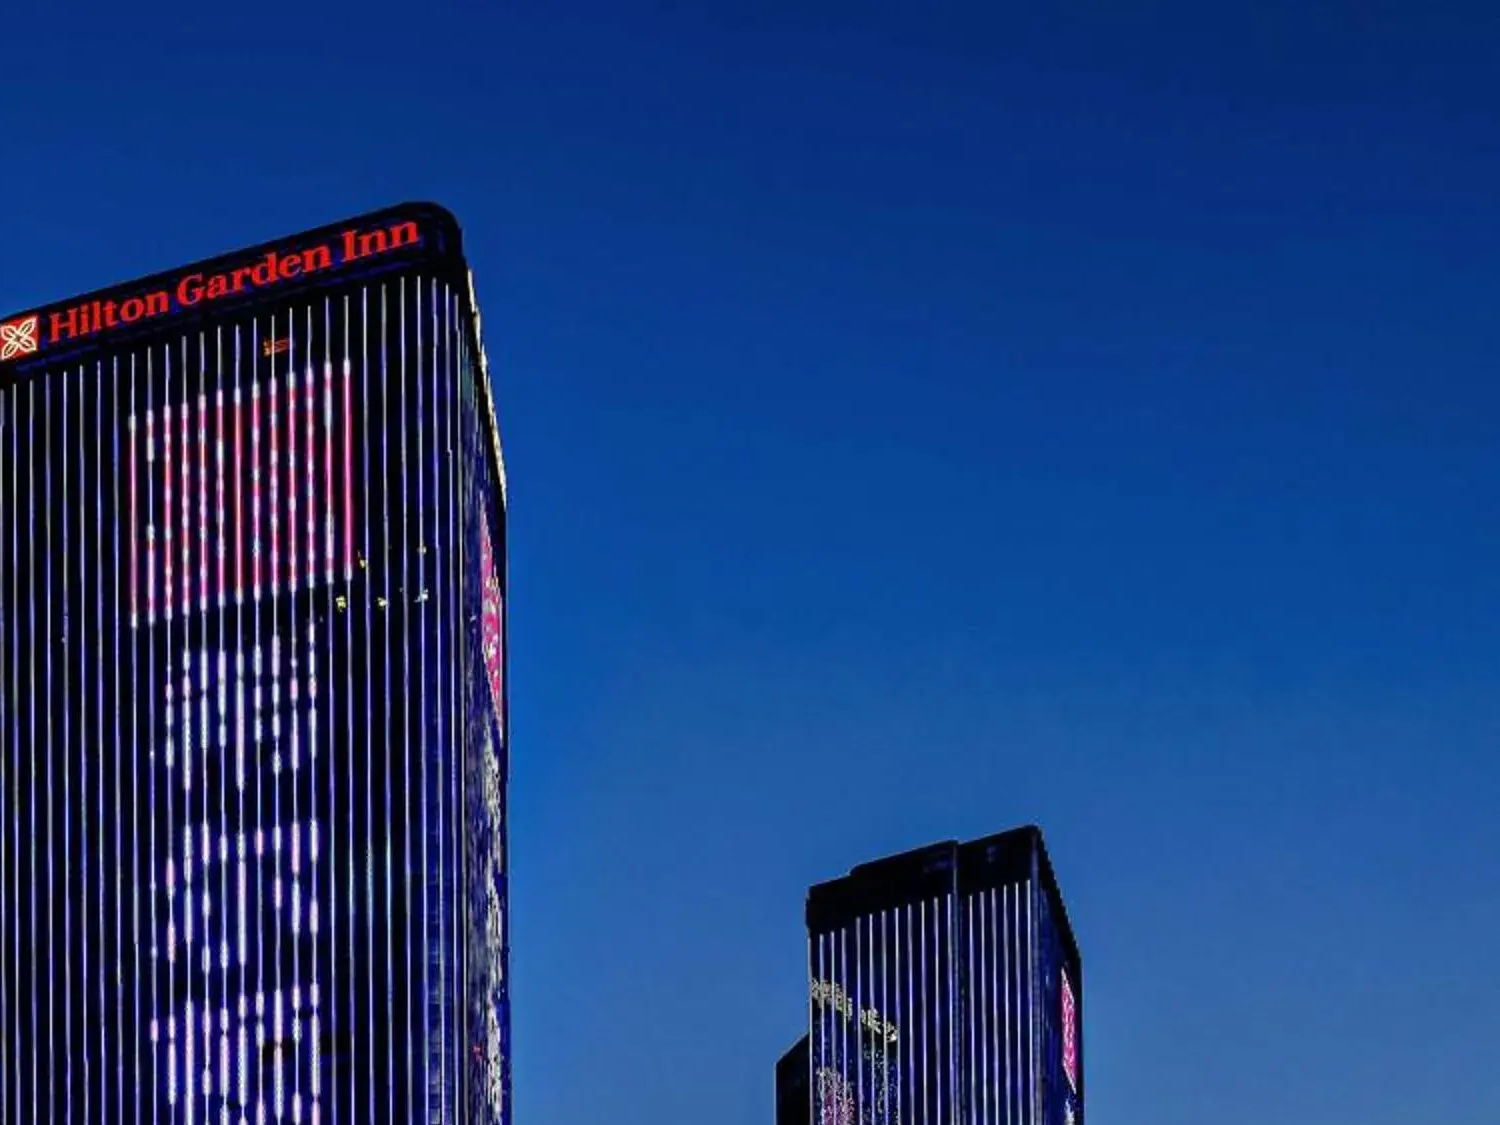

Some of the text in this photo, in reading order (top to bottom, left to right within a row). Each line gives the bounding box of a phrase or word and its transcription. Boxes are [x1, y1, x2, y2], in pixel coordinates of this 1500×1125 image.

[48, 219, 420, 343] Hilton Garden Inn
